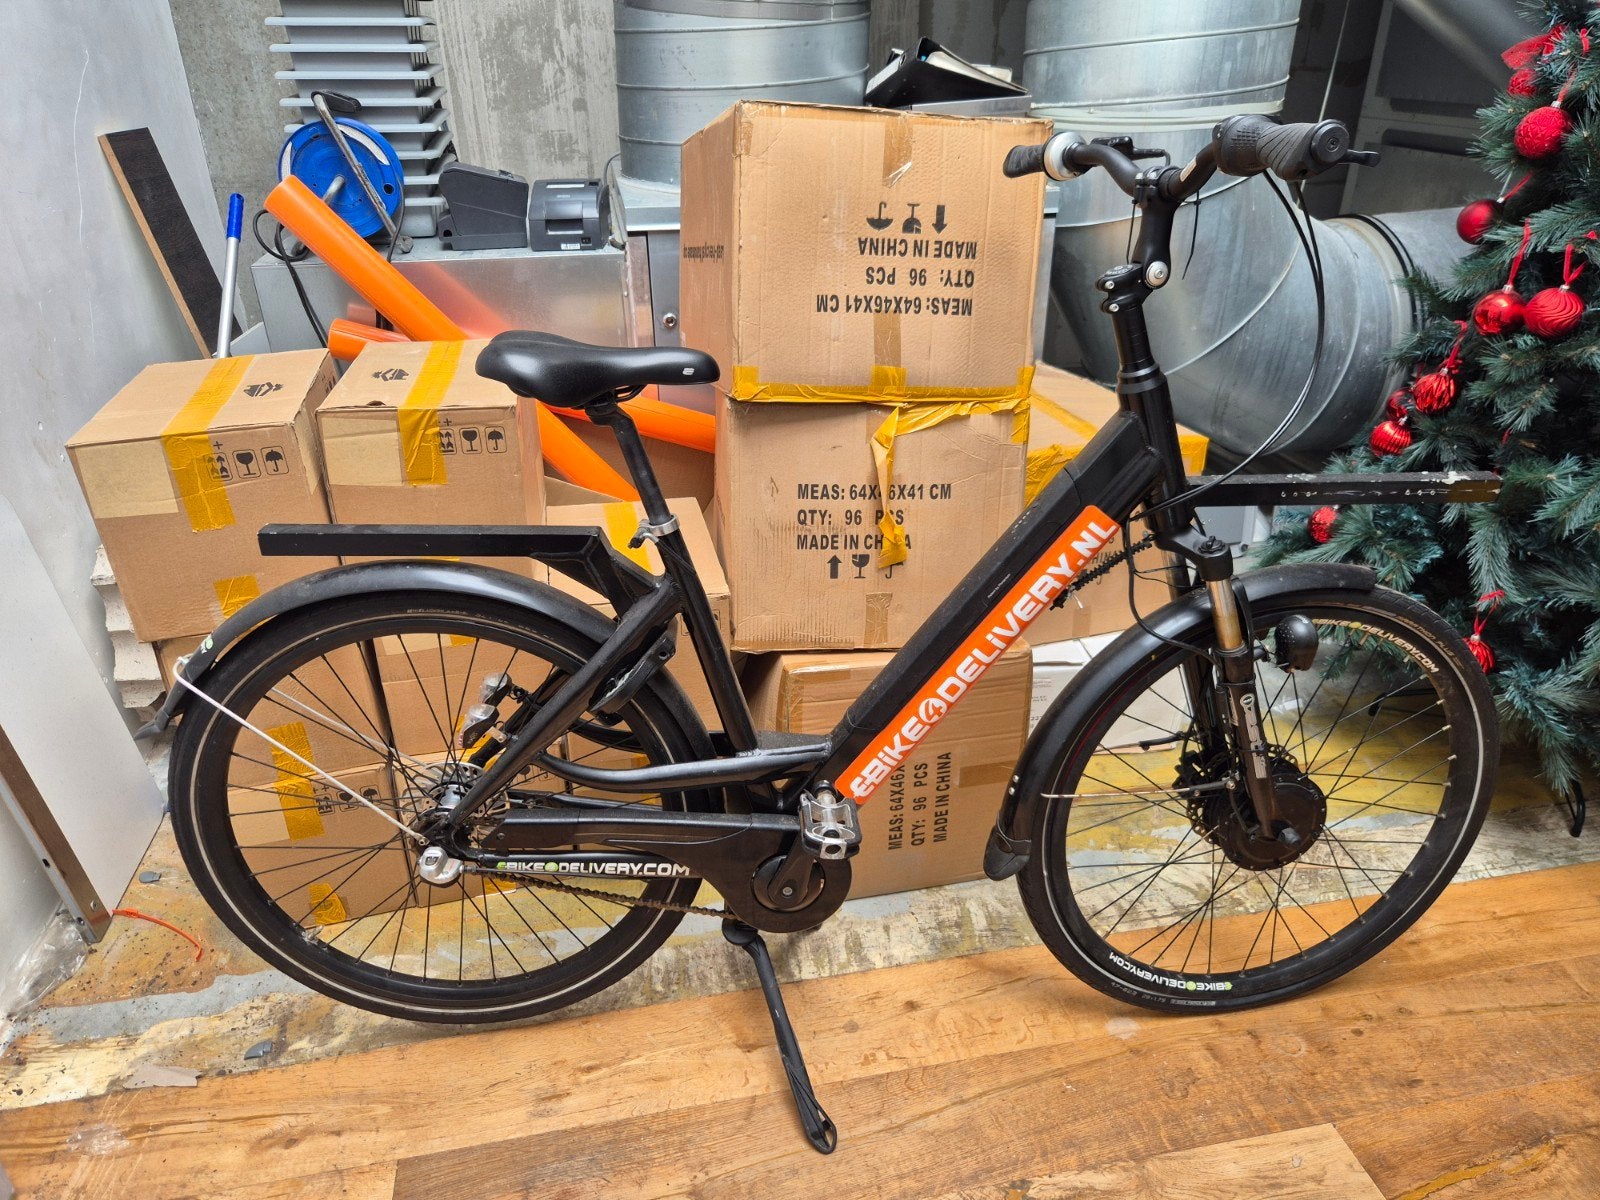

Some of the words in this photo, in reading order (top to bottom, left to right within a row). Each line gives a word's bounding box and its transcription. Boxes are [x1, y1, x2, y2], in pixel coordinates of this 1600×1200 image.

[857, 236, 908, 258] CHINA
[911, 239, 930, 259] IN
[933, 240, 978, 260] MADE
[865, 266, 896, 286] PCS
[909, 268, 927, 287] 96
[939, 269, 975, 289] QTY:
[816, 294, 840, 314] CM
[845, 294, 922, 316] 64X46X41
[926, 297, 973, 317] MEAS:
[797, 483, 845, 501] MEAS:
[849, 483, 924, 501] 64X6X41
[929, 483, 952, 500] CM
[797, 509, 832, 527] QTY:
[844, 509, 863, 526] 96
[874, 509, 904, 526] PS
[796, 534, 839, 550] MADE
[843, 534, 859, 550] IN
[863, 533, 912, 550] CHA
[913, 762, 928, 788] PCS
[936, 752, 951, 791] CHINA
[889, 764, 905, 811] 64X46X
[912, 796, 928, 811] 96
[935, 794, 950, 809] IN
[888, 813, 904, 850] MEAS:
[911, 819, 926, 847] QTY:
[933, 810, 949, 843] MADE
